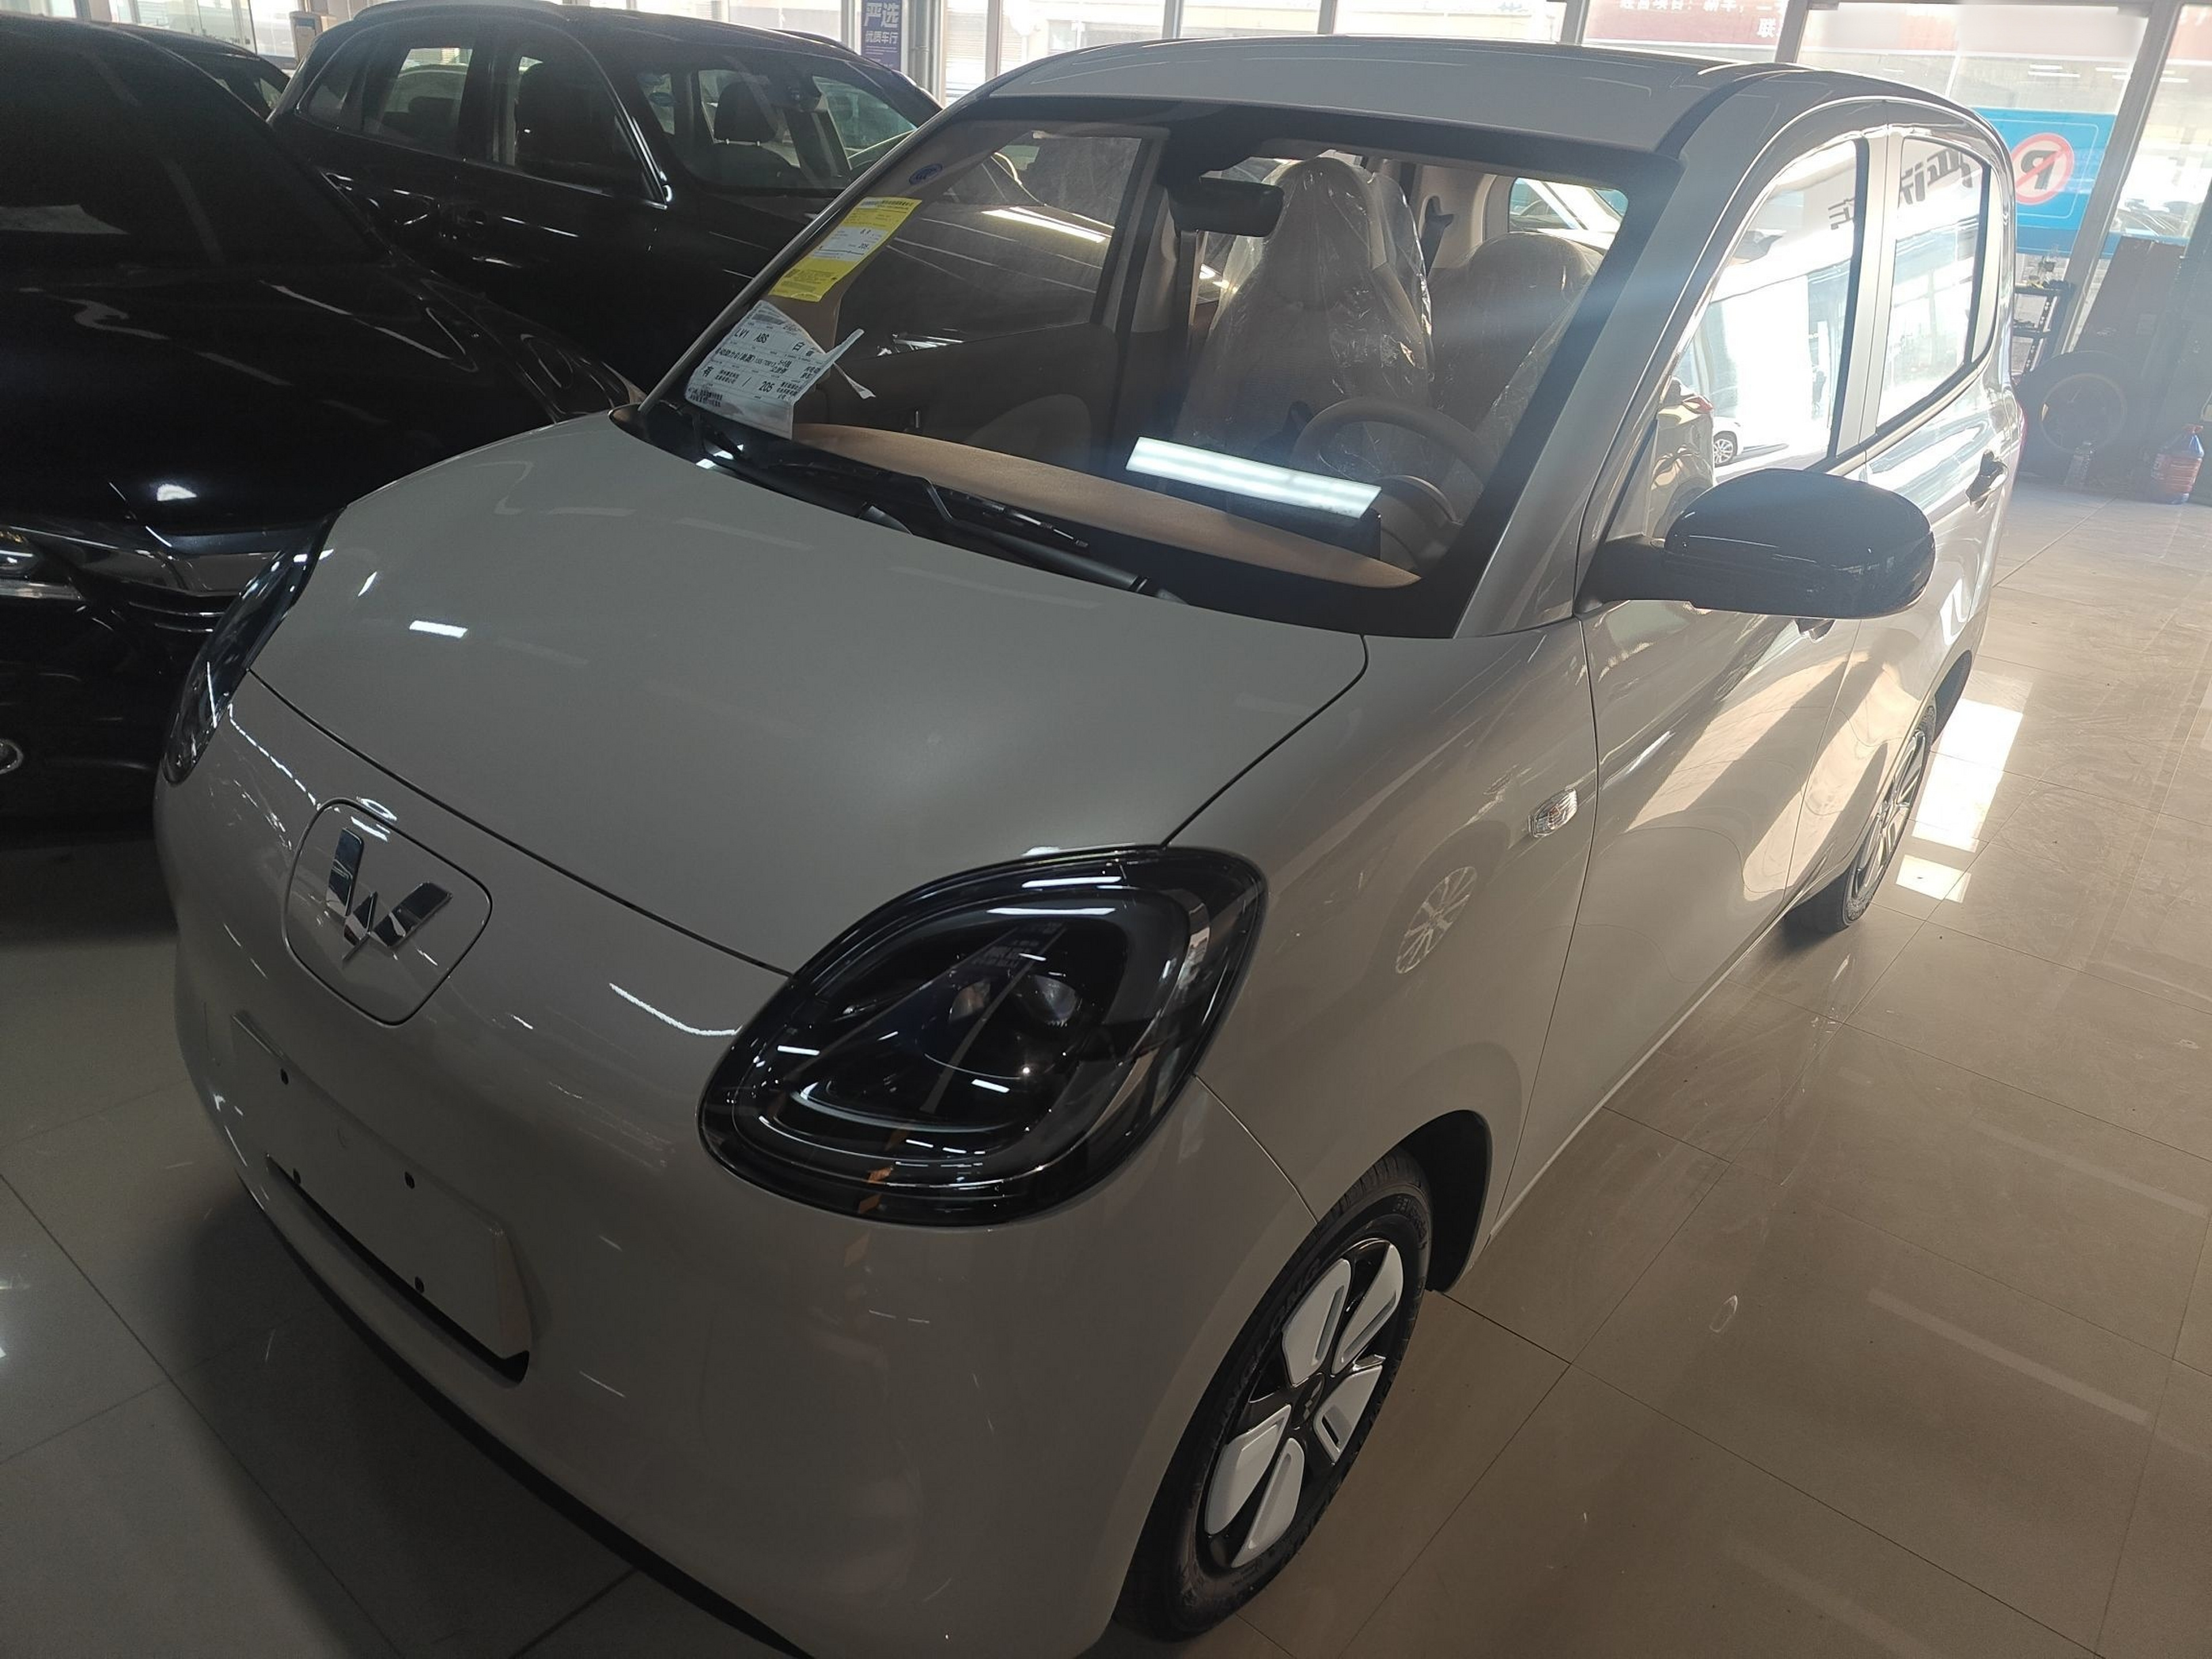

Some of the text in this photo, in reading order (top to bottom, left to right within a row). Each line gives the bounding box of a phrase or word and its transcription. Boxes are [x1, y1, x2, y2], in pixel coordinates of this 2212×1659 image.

[865, 2, 899, 28] 严选
[753, 332, 770, 344] ABS
[758, 380, 775, 393] 205
